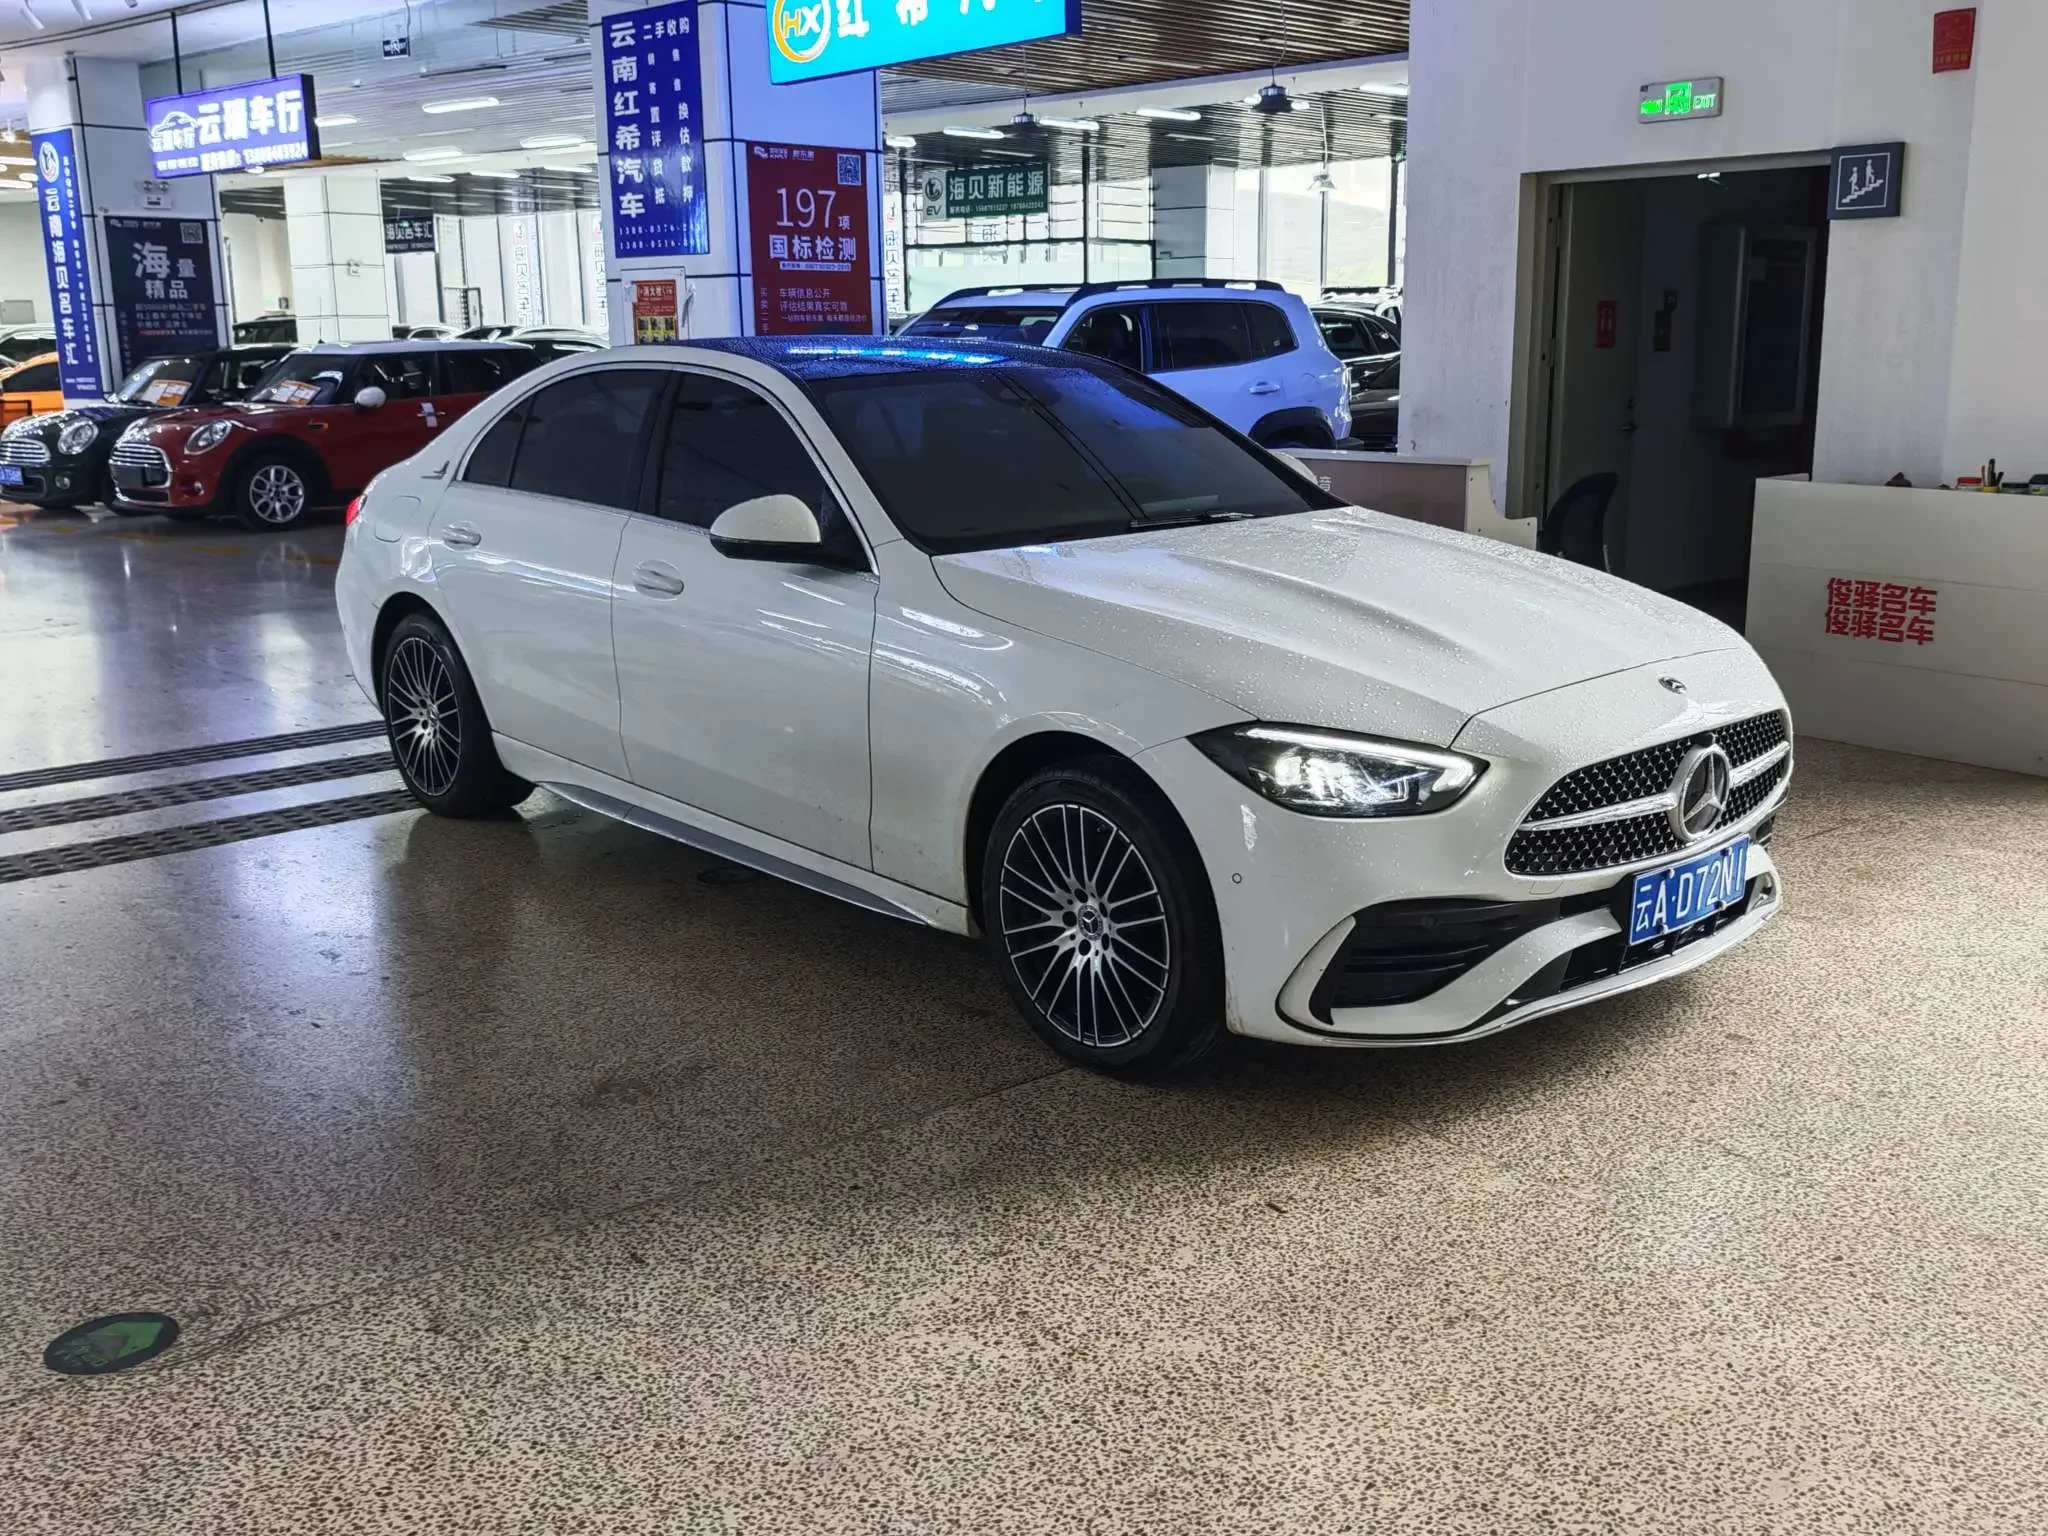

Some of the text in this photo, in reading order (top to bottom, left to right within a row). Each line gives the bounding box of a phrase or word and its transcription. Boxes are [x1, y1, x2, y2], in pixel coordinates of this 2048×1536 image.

[643, 16, 690, 41] 二手收购
[1693, 94, 1717, 109] EXIT
[609, 20, 646, 219] 云南红希汽车
[651, 127, 690, 147] 评估
[949, 170, 1044, 201] 海贝新能源
[926, 205, 943, 216] EV
[132, 242, 197, 279] 海量
[768, 234, 857, 262] 国标检测
[144, 279, 188, 299] 精品
